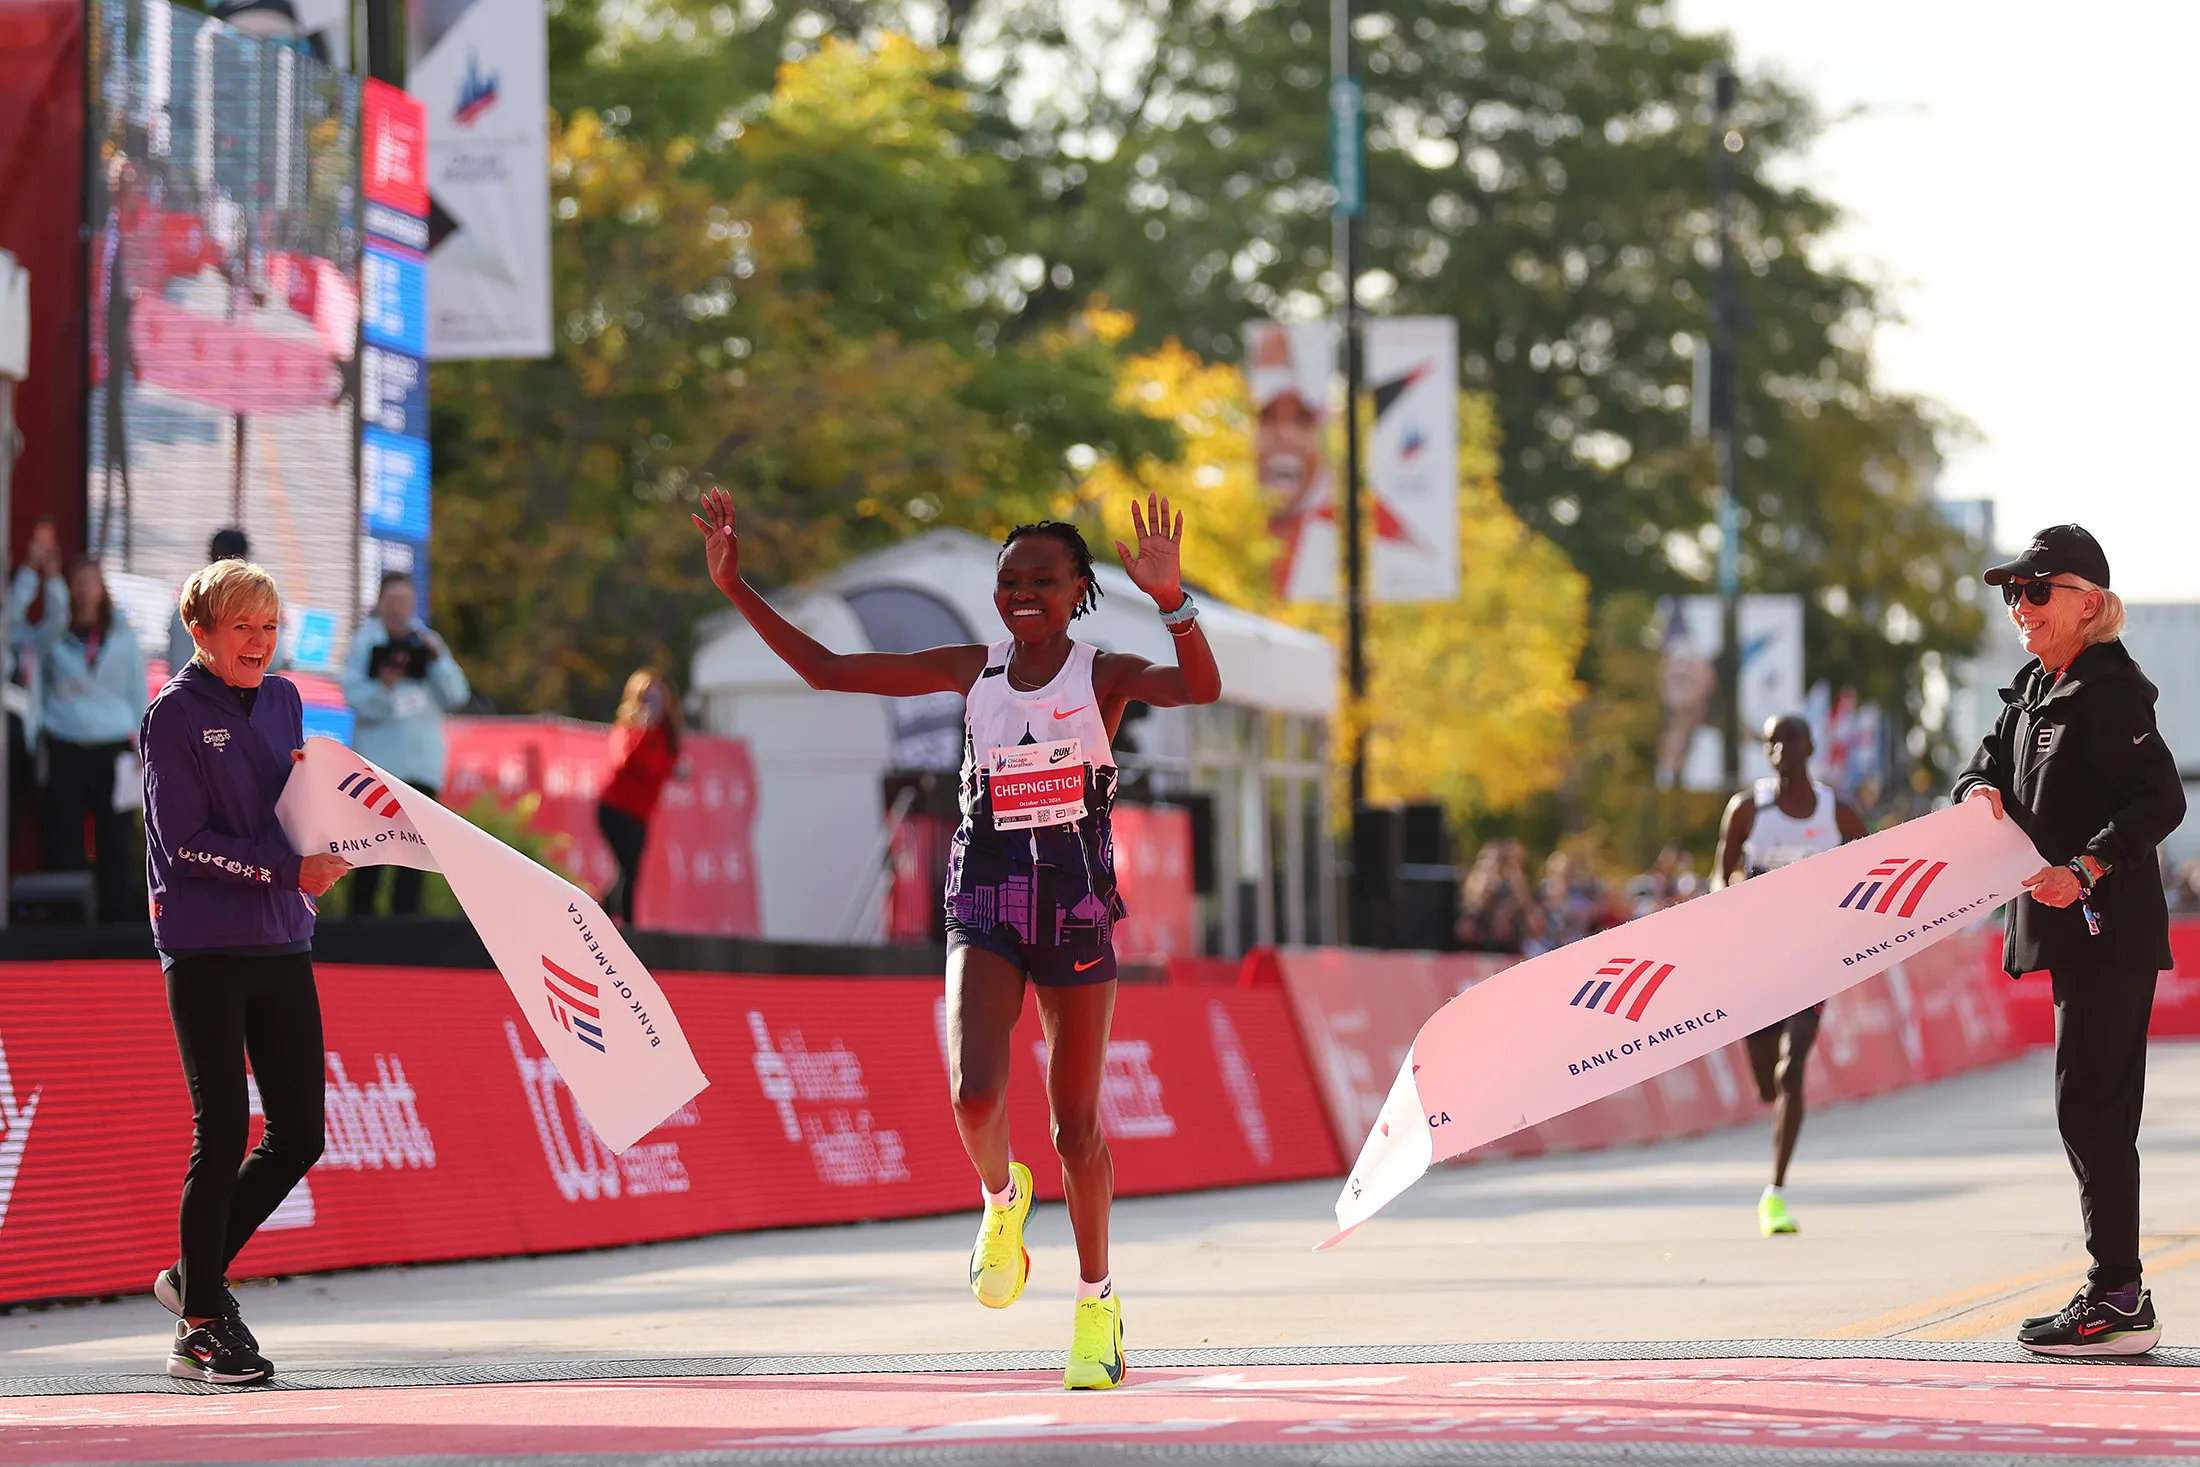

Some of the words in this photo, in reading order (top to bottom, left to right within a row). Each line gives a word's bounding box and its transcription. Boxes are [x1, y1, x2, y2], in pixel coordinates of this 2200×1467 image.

[1007, 757, 1028, 765] Chicago
[1053, 747, 1071, 757] RUN
[994, 775, 1082, 798] CHEPNGETICH
[1039, 798, 1048, 806] 13,
[329, 838, 372, 854] BANK
[375, 830, 396, 842] OF
[567, 902, 617, 976] AMERICA
[1842, 940, 1893, 967] BANK
[1894, 929, 1917, 943] OF
[1921, 892, 2000, 932] AMERICA
[612, 979, 632, 999] OF
[630, 1001, 661, 1048] BANK
[1567, 1049, 1618, 1076] BANK
[1620, 1039, 1644, 1056] OF
[1647, 1008, 1728, 1047] AMERICA
[1428, 1111, 1452, 1128] CA
